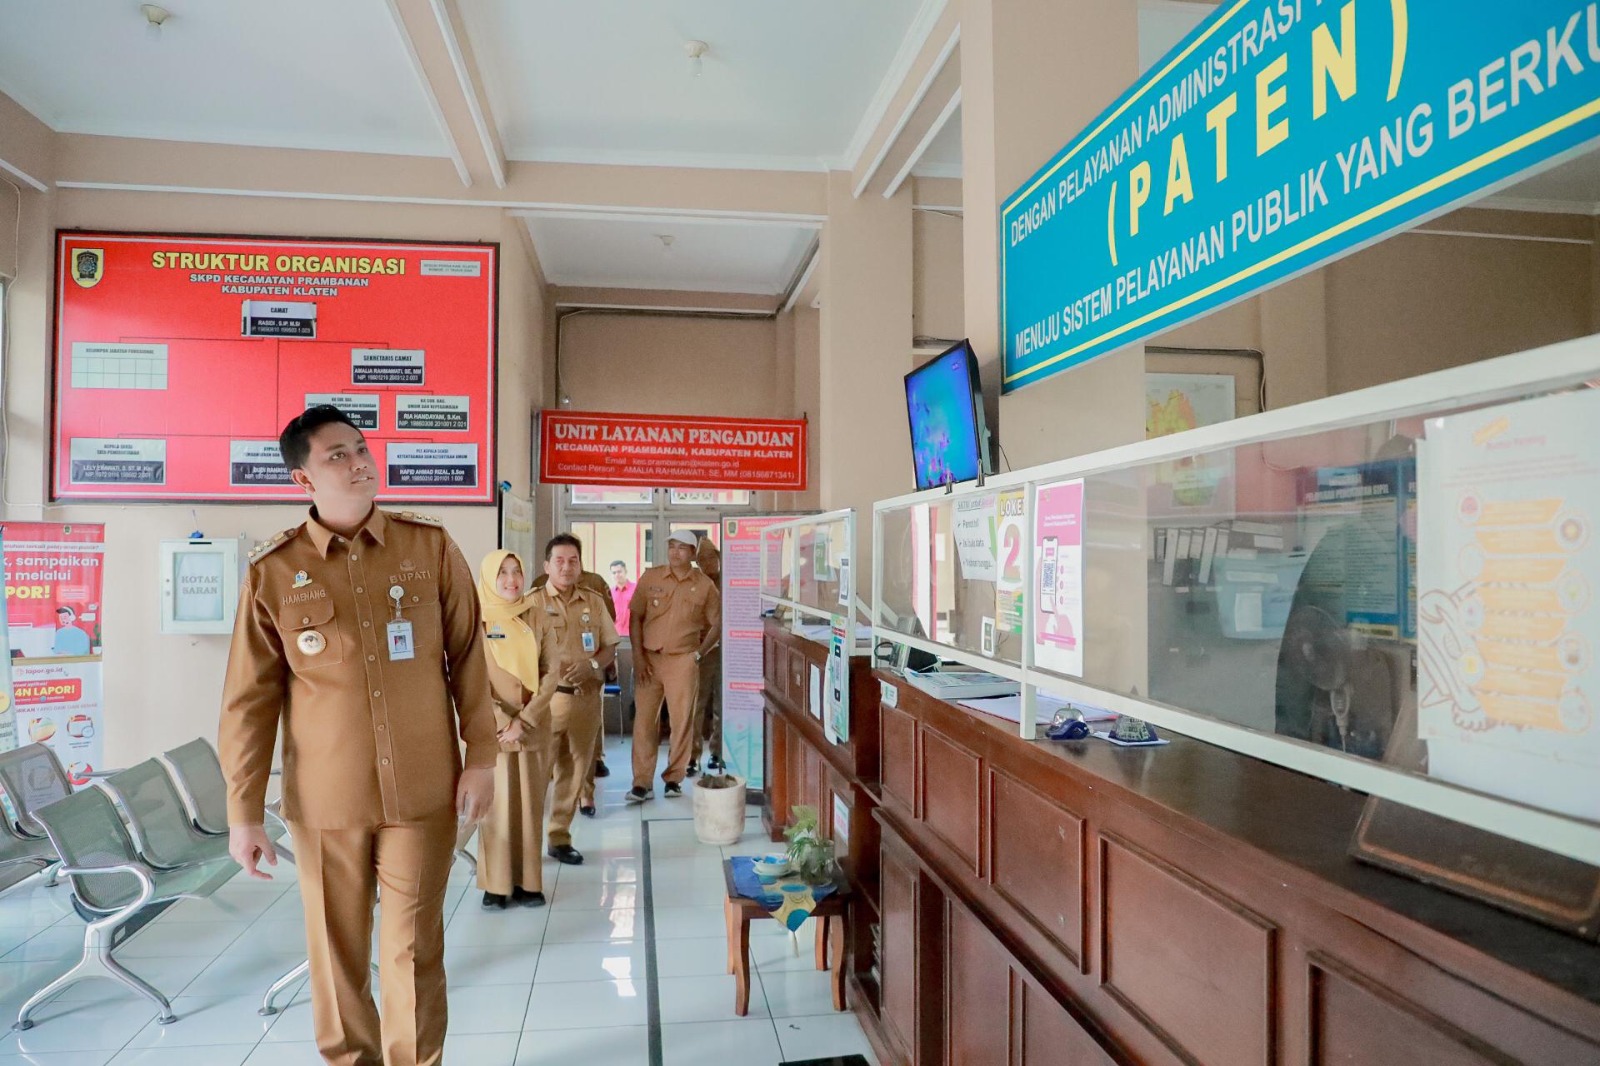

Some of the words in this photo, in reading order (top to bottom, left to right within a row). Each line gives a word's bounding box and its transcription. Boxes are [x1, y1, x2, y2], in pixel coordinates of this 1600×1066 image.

[1011, 187, 1056, 248] DENGAN
[1059, 114, 1142, 211] PELAYANAN
[1015, 310, 1060, 360] MENUJU
[1062, 282, 1112, 336] SISTEM
[1116, 220, 1224, 311] PELAYANAN
[1232, 160, 1329, 253] PUBLIK
[1335, 102, 1434, 195] YANG
[152, 251, 269, 272] STRUKTUR
[275, 255, 406, 275] ORGANISASI
[190, 273, 221, 283] SKPD
[224, 275, 294, 285] KECAMATAN
[297, 277, 369, 287] PRAMBANAN
[222, 285, 290, 295] KABUPATEN
[293, 287, 338, 296] KLATEN
[555, 424, 598, 440] UNIT
[602, 425, 685, 443] LAYANAN
[688, 429, 794, 447] PENGADUAN
[555, 443, 618, 453] KECAMATAN
[621, 446, 688, 456] PRAMBANAN,
[691, 448, 751, 457] KABUPATEN
[753, 450, 793, 458] KLATEN
[557, 463, 587, 472] Contact
[588, 465, 615, 473] Person
[623, 466, 654, 474] AMALIA
[1000, 499, 1024, 517] LOKE
[1004, 524, 1021, 578] 2
[16, 556, 98, 569] sampaikan
[16, 570, 71, 580] melalui
[389, 570, 431, 584] BUPATI
[282, 589, 326, 605] HAMENANG
[34, 685, 75, 696] LAPOR!
